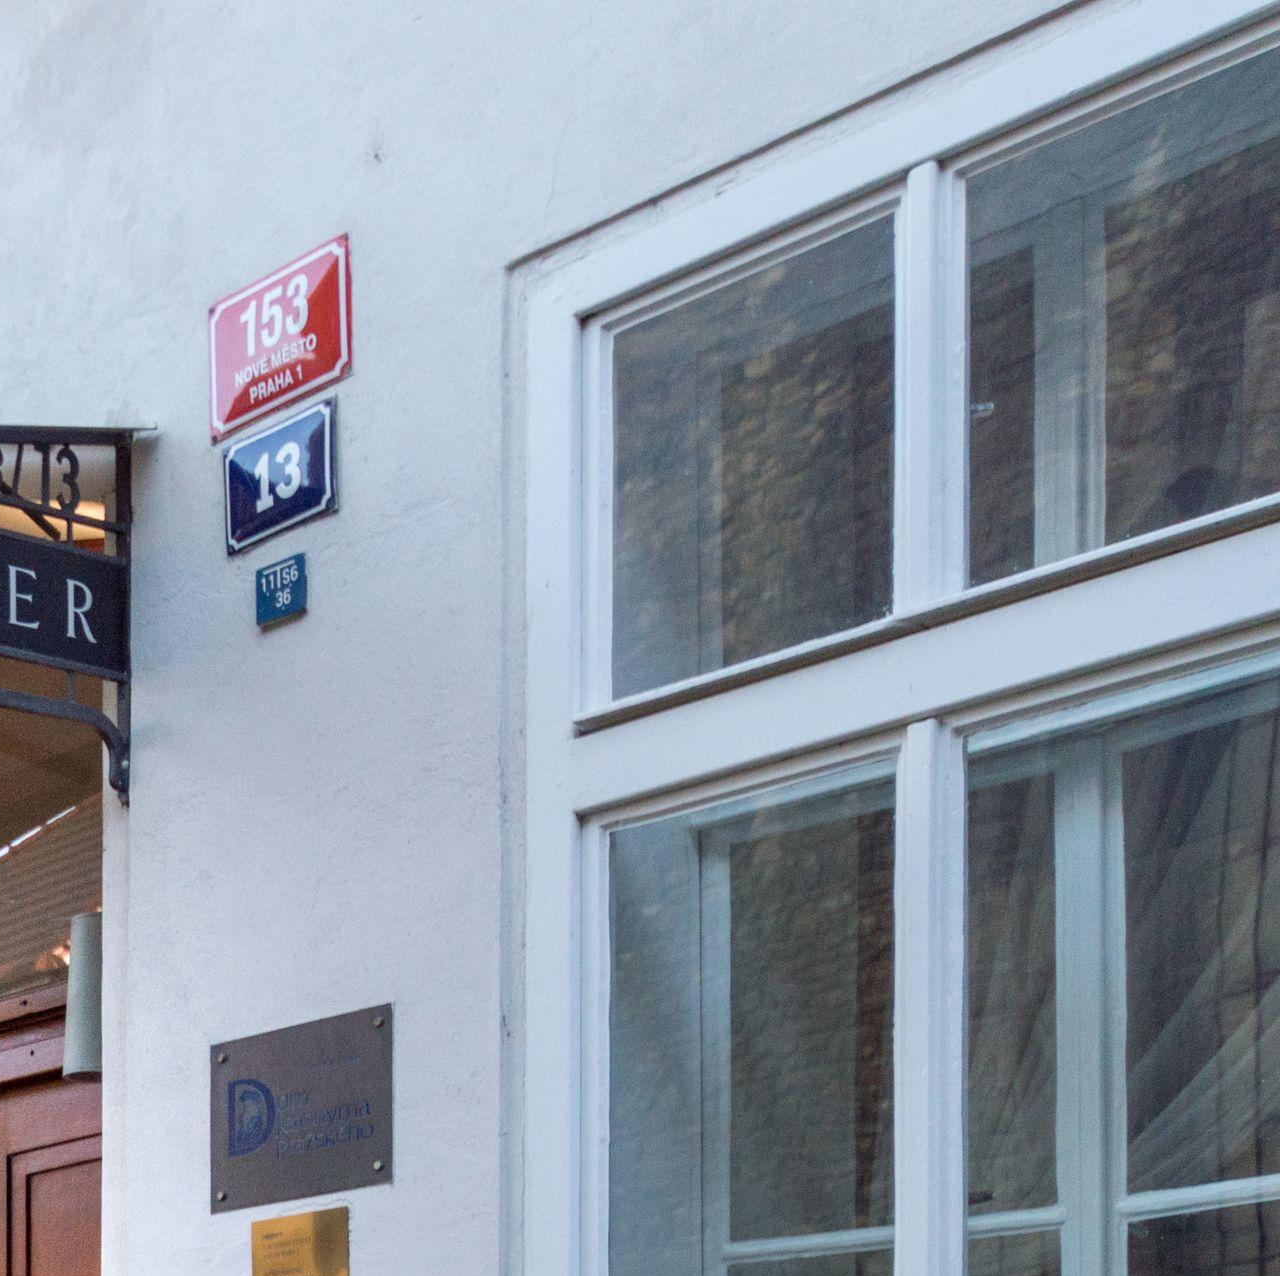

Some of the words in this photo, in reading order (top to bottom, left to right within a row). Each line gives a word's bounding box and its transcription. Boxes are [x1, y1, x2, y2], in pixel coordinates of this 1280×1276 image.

[239, 273, 309, 358] 153
[271, 333, 317, 369] MĚSTO
[248, 368, 294, 404] PRAHA
[296, 364, 303, 380] 1
[254, 441, 302, 513] 13
